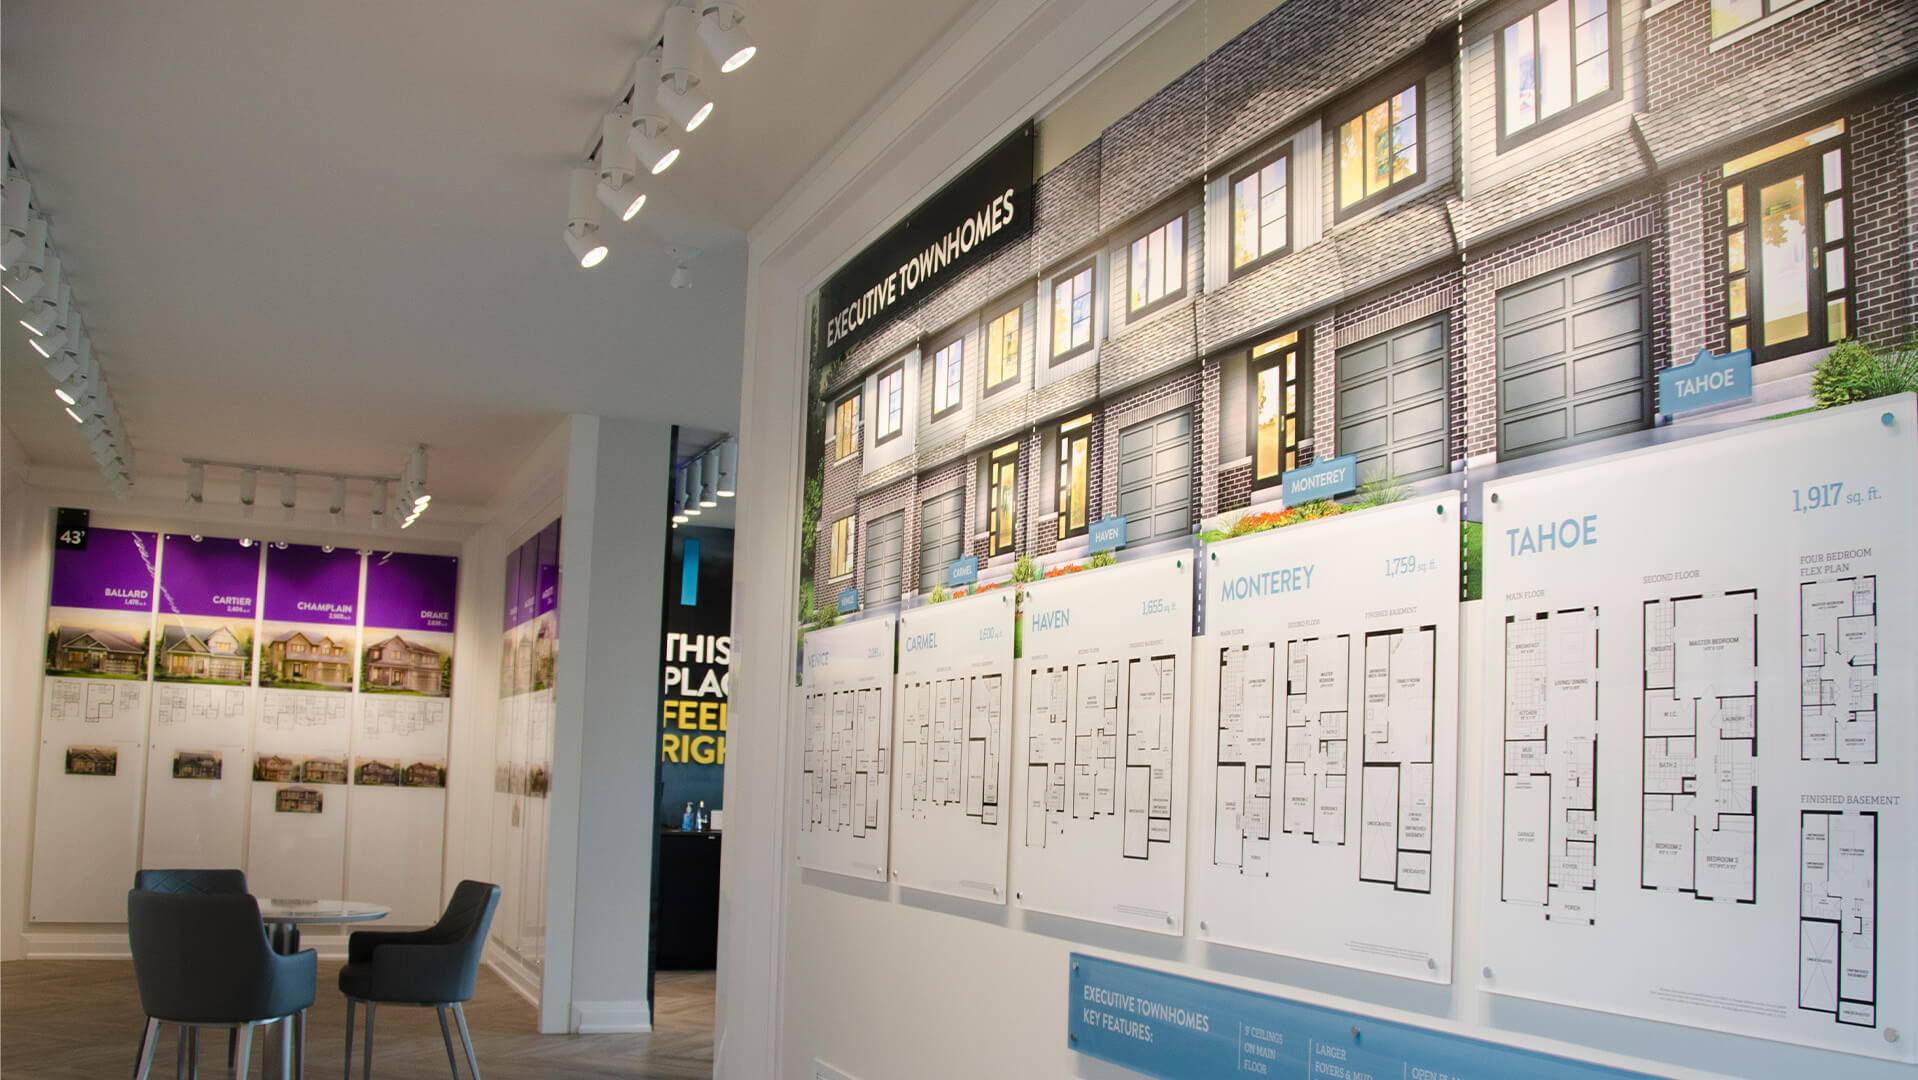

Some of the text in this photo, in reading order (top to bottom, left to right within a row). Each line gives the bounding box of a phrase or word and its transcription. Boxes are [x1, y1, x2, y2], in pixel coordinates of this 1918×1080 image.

[827, 188, 1014, 348] EXECUTIVE TOWNHOMES
[1675, 368, 1735, 397] TAHOE
[1291, 467, 1346, 494] MONTEREY
[1792, 482, 1882, 514] 1,917 sq. ft.
[1095, 528, 1119, 543] HAVEN
[1506, 515, 1597, 556] TAHOE
[1800, 548, 1872, 564] FOUR BEDROOM
[953, 565, 972, 578] CARMEL
[1385, 555, 1416, 579] 1,759
[1800, 563, 1849, 577] FLEX PLAN
[1221, 564, 1315, 603] MONTEREY
[1643, 570, 1700, 584] SECOND FLOOR
[105, 588, 148, 599] BALLARD
[212, 595, 251, 606] CARTIER
[1505, 589, 1545, 601] MAIN FLOOR
[297, 601, 352, 613] CHAMPLAIN
[420, 610, 449, 620] DRAKE
[1032, 608, 1070, 633] HAVEN
[666, 633, 731, 665] THIS
[906, 632, 938, 652] CARMEL
[1800, 794, 1901, 805] FINISHED BASEMENT
[1083, 984, 1209, 1032] EXECUTIVE TOWNHOMES
[1083, 1008, 1153, 1043] KEY FEATURES:
[1251, 1027, 1283, 1045] CEILINGS
[1244, 1042, 1276, 1060] ON MAIN
[1315, 1042, 1347, 1061] LARGER
[1243, 1059, 1267, 1075] FLOOR
[1315, 1061, 1344, 1079] FOYERS
